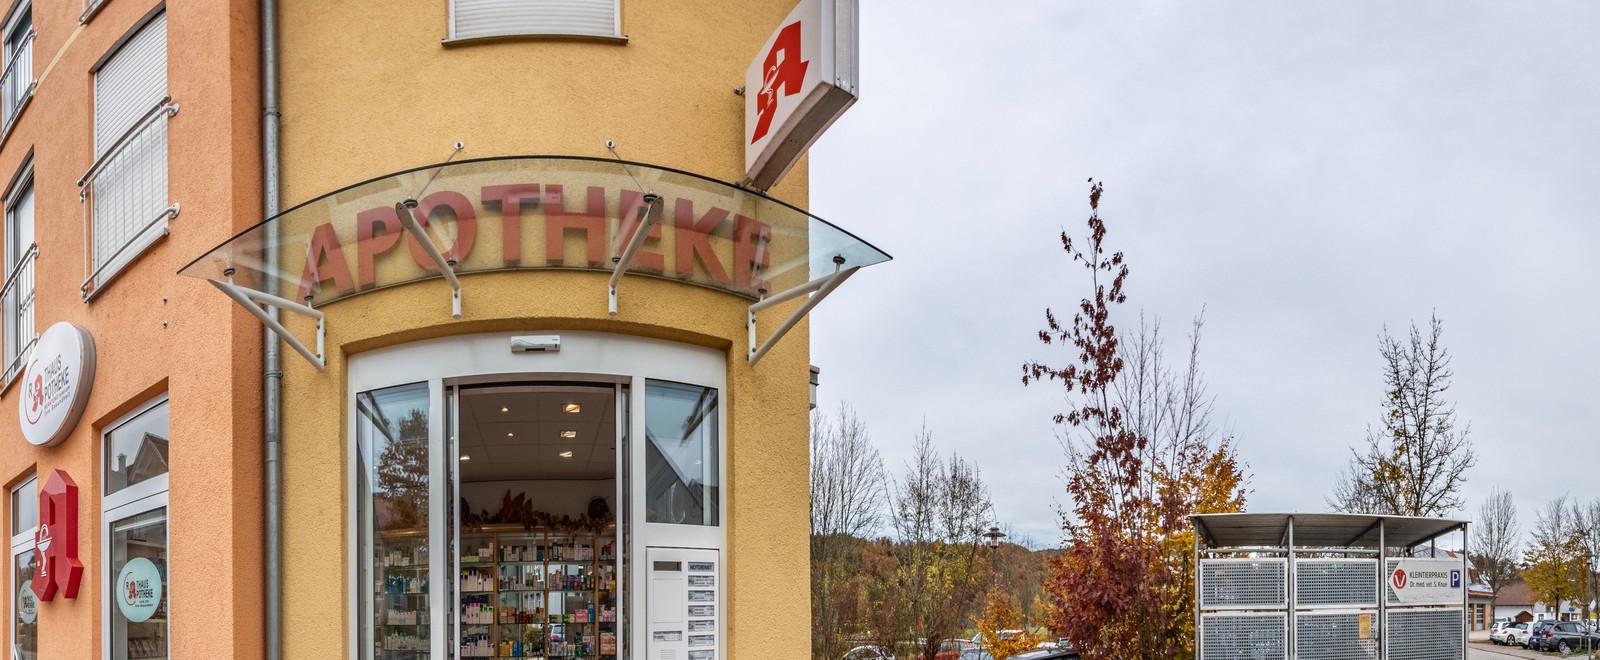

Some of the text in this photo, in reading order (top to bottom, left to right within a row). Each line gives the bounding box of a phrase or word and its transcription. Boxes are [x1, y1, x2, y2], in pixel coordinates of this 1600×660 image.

[296, 183, 772, 304] APOTHEKE
[1409, 571, 1448, 579] KLEINTIERPRAXIS
[1452, 571, 1459, 587] P
